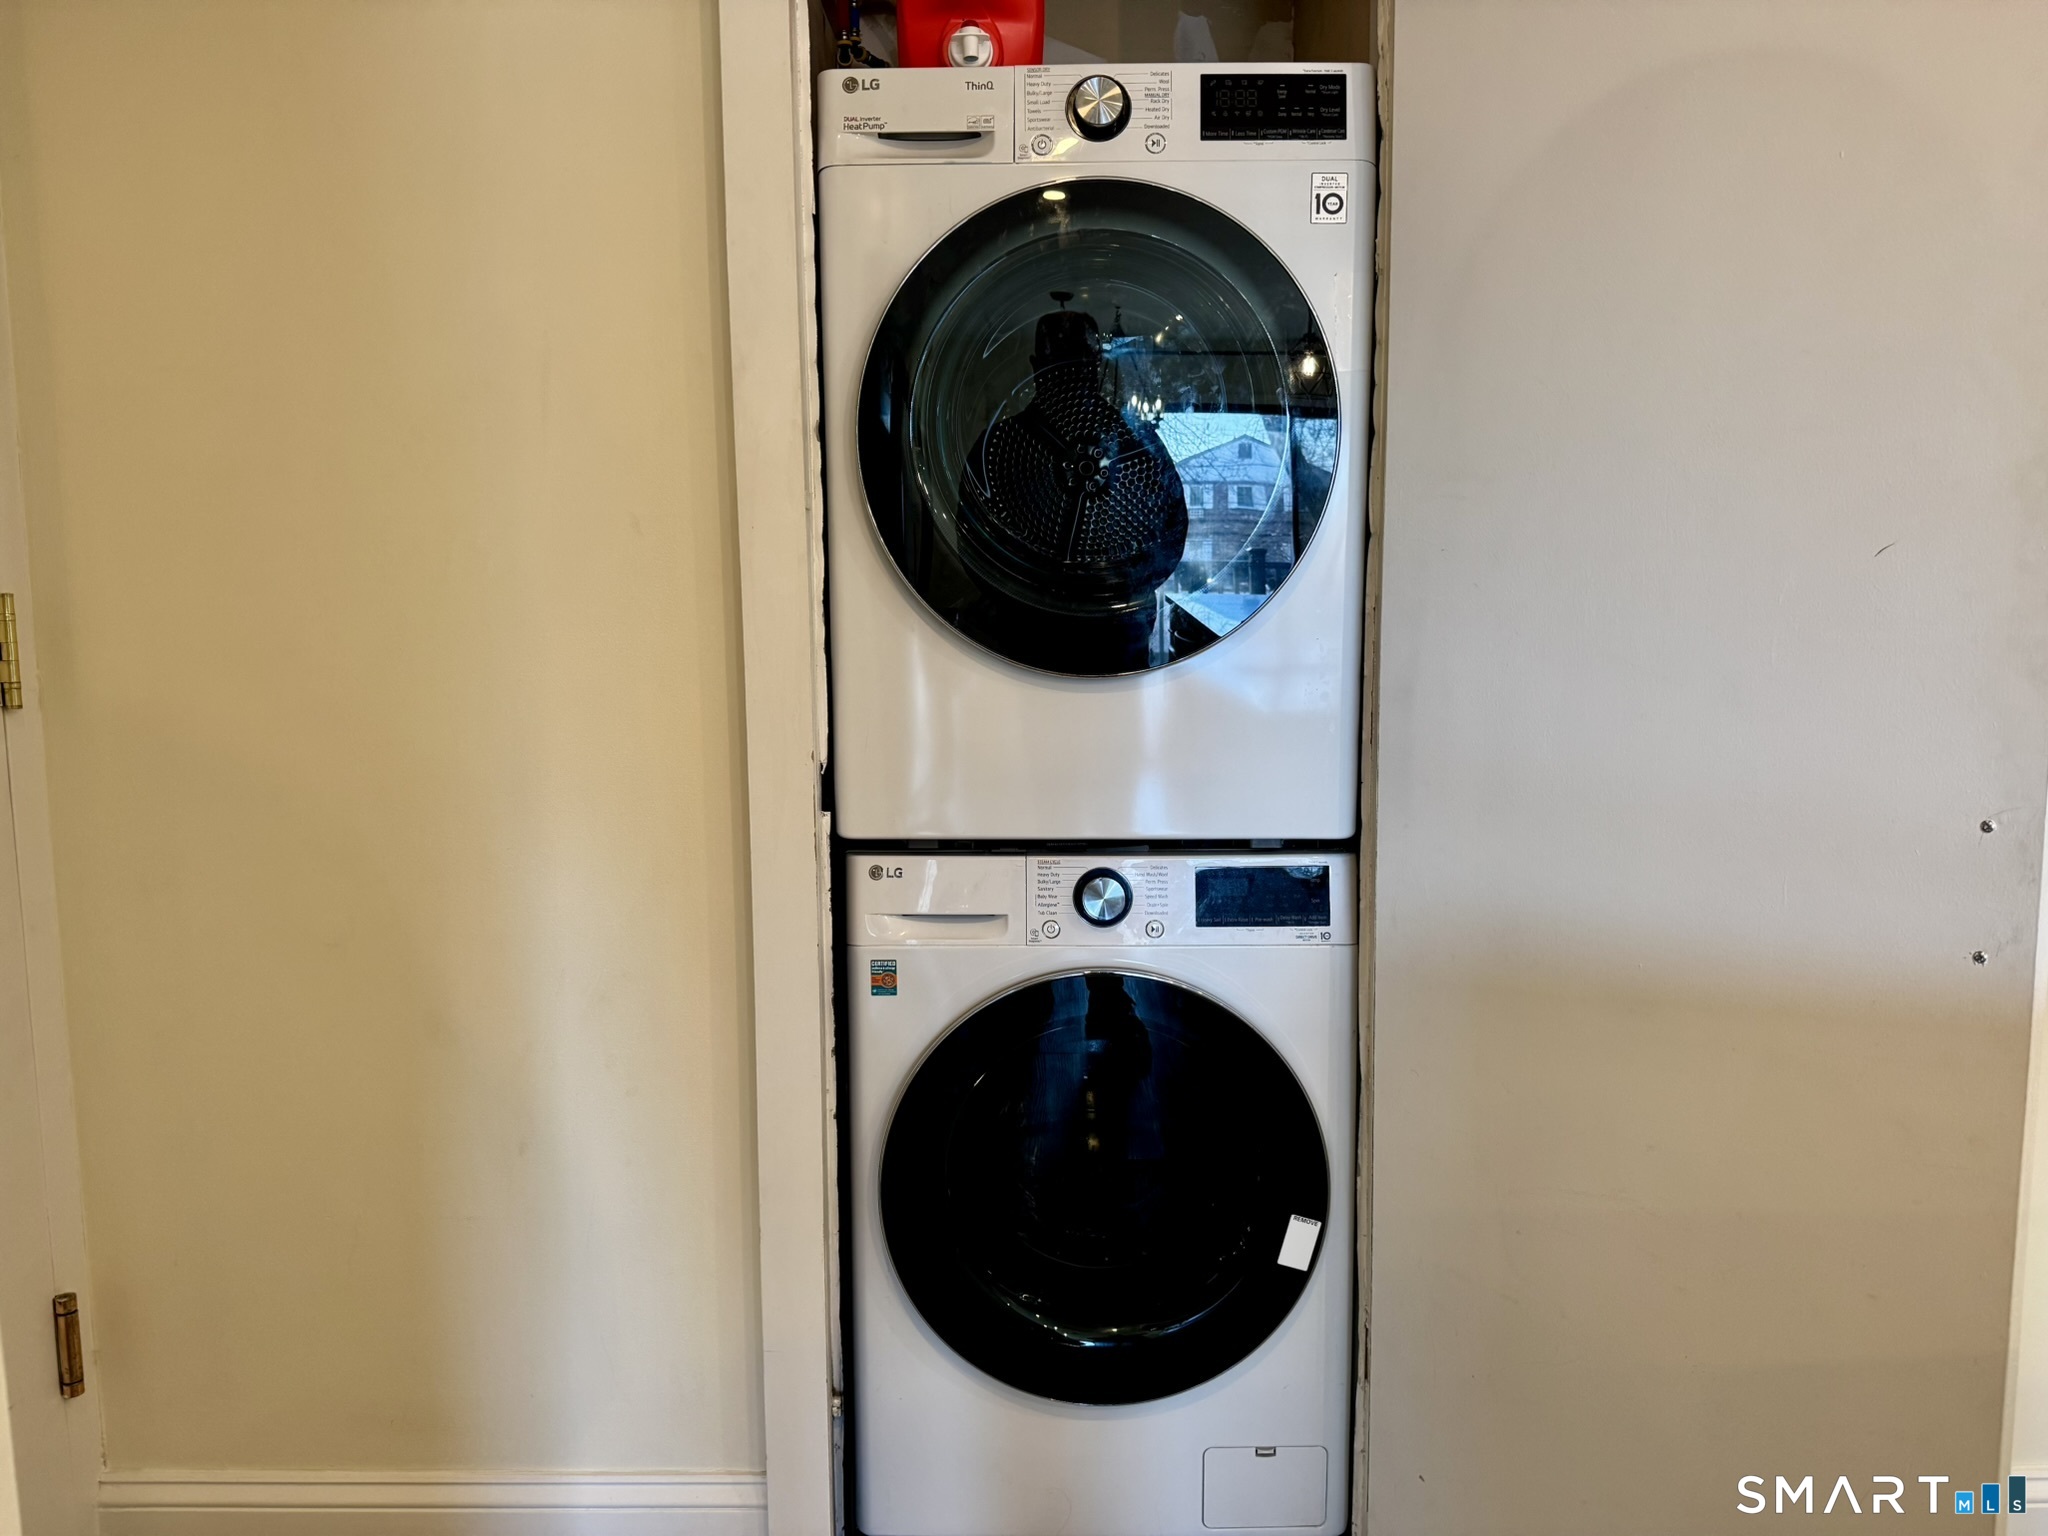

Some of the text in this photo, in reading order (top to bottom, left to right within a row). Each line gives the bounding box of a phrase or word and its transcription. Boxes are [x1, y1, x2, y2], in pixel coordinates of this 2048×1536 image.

[862, 78, 880, 90] LG
[965, 81, 994, 90] ThinQ
[1315, 192, 1344, 215] 10
[886, 867, 903, 878] LG
[1320, 932, 1332, 940] 10
[1292, 1215, 1318, 1226] REMOVE
